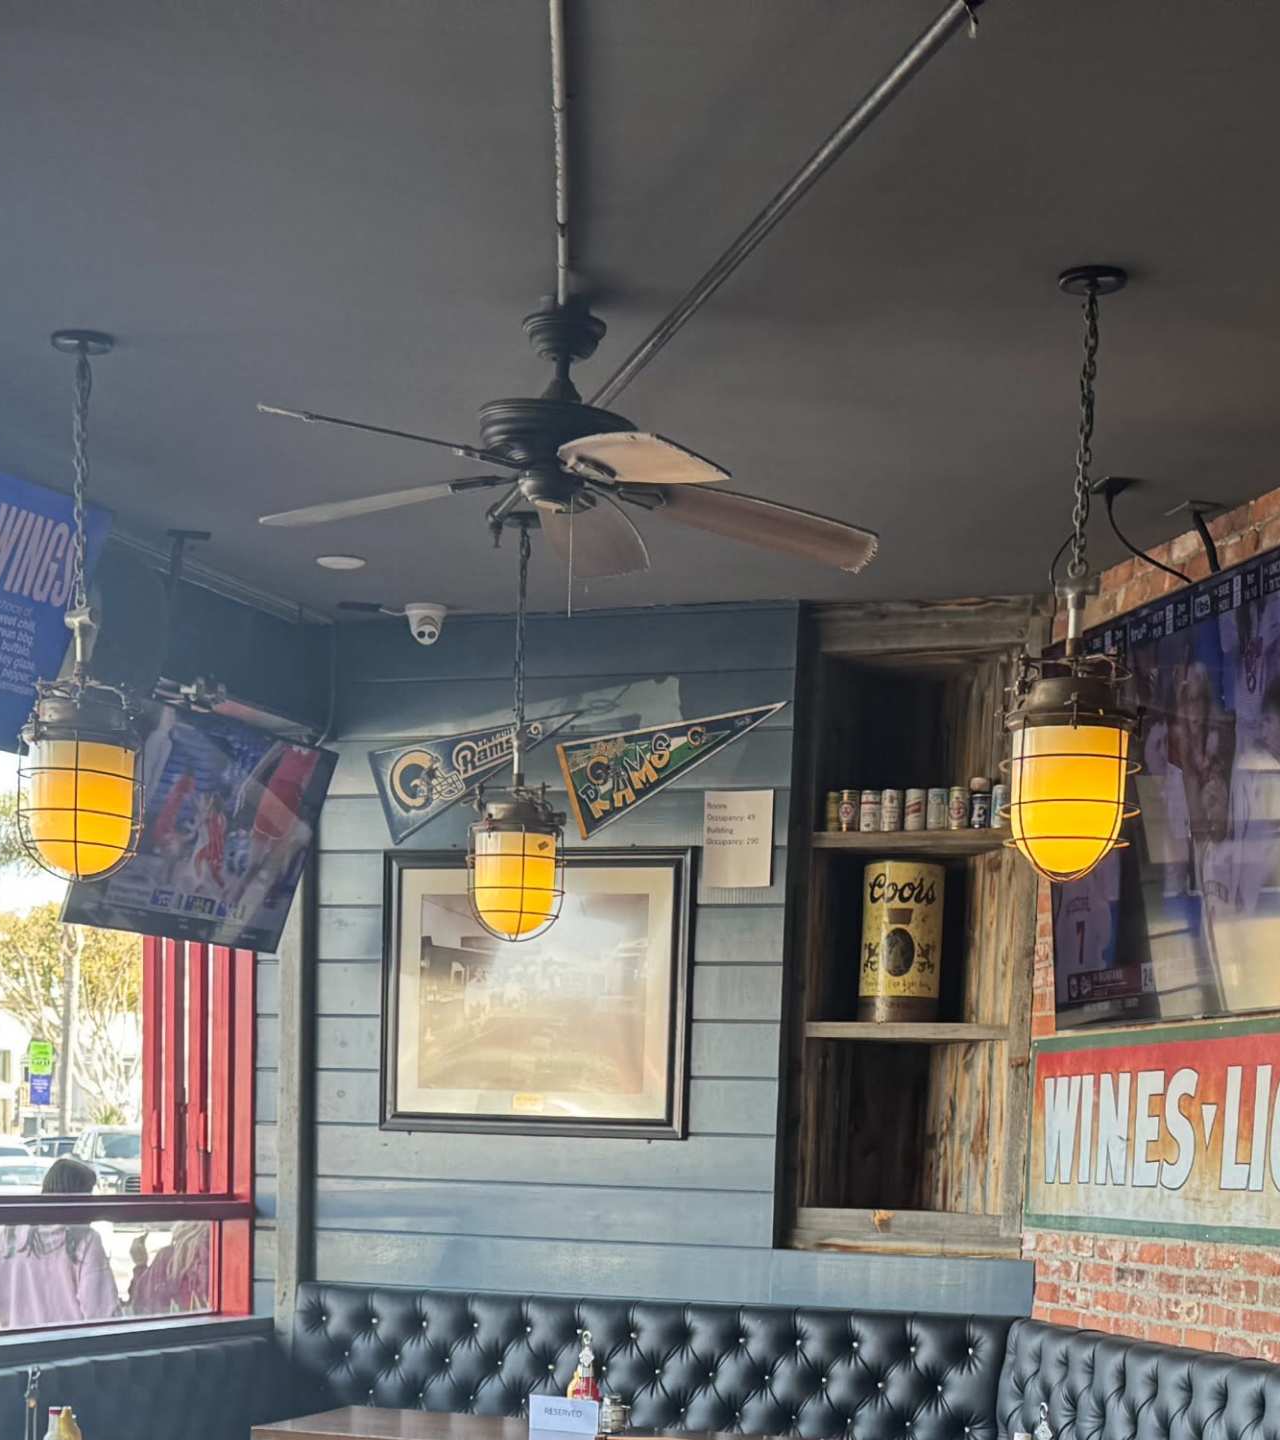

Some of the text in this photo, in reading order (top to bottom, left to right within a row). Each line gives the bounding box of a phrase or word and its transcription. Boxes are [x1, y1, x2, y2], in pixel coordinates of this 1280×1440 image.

[578, 733, 671, 819] RAMS
[868, 872, 938, 906] Coors
[1043, 1065, 1200, 1193] WINES
[544, 1407, 583, 1418] RESERVED
